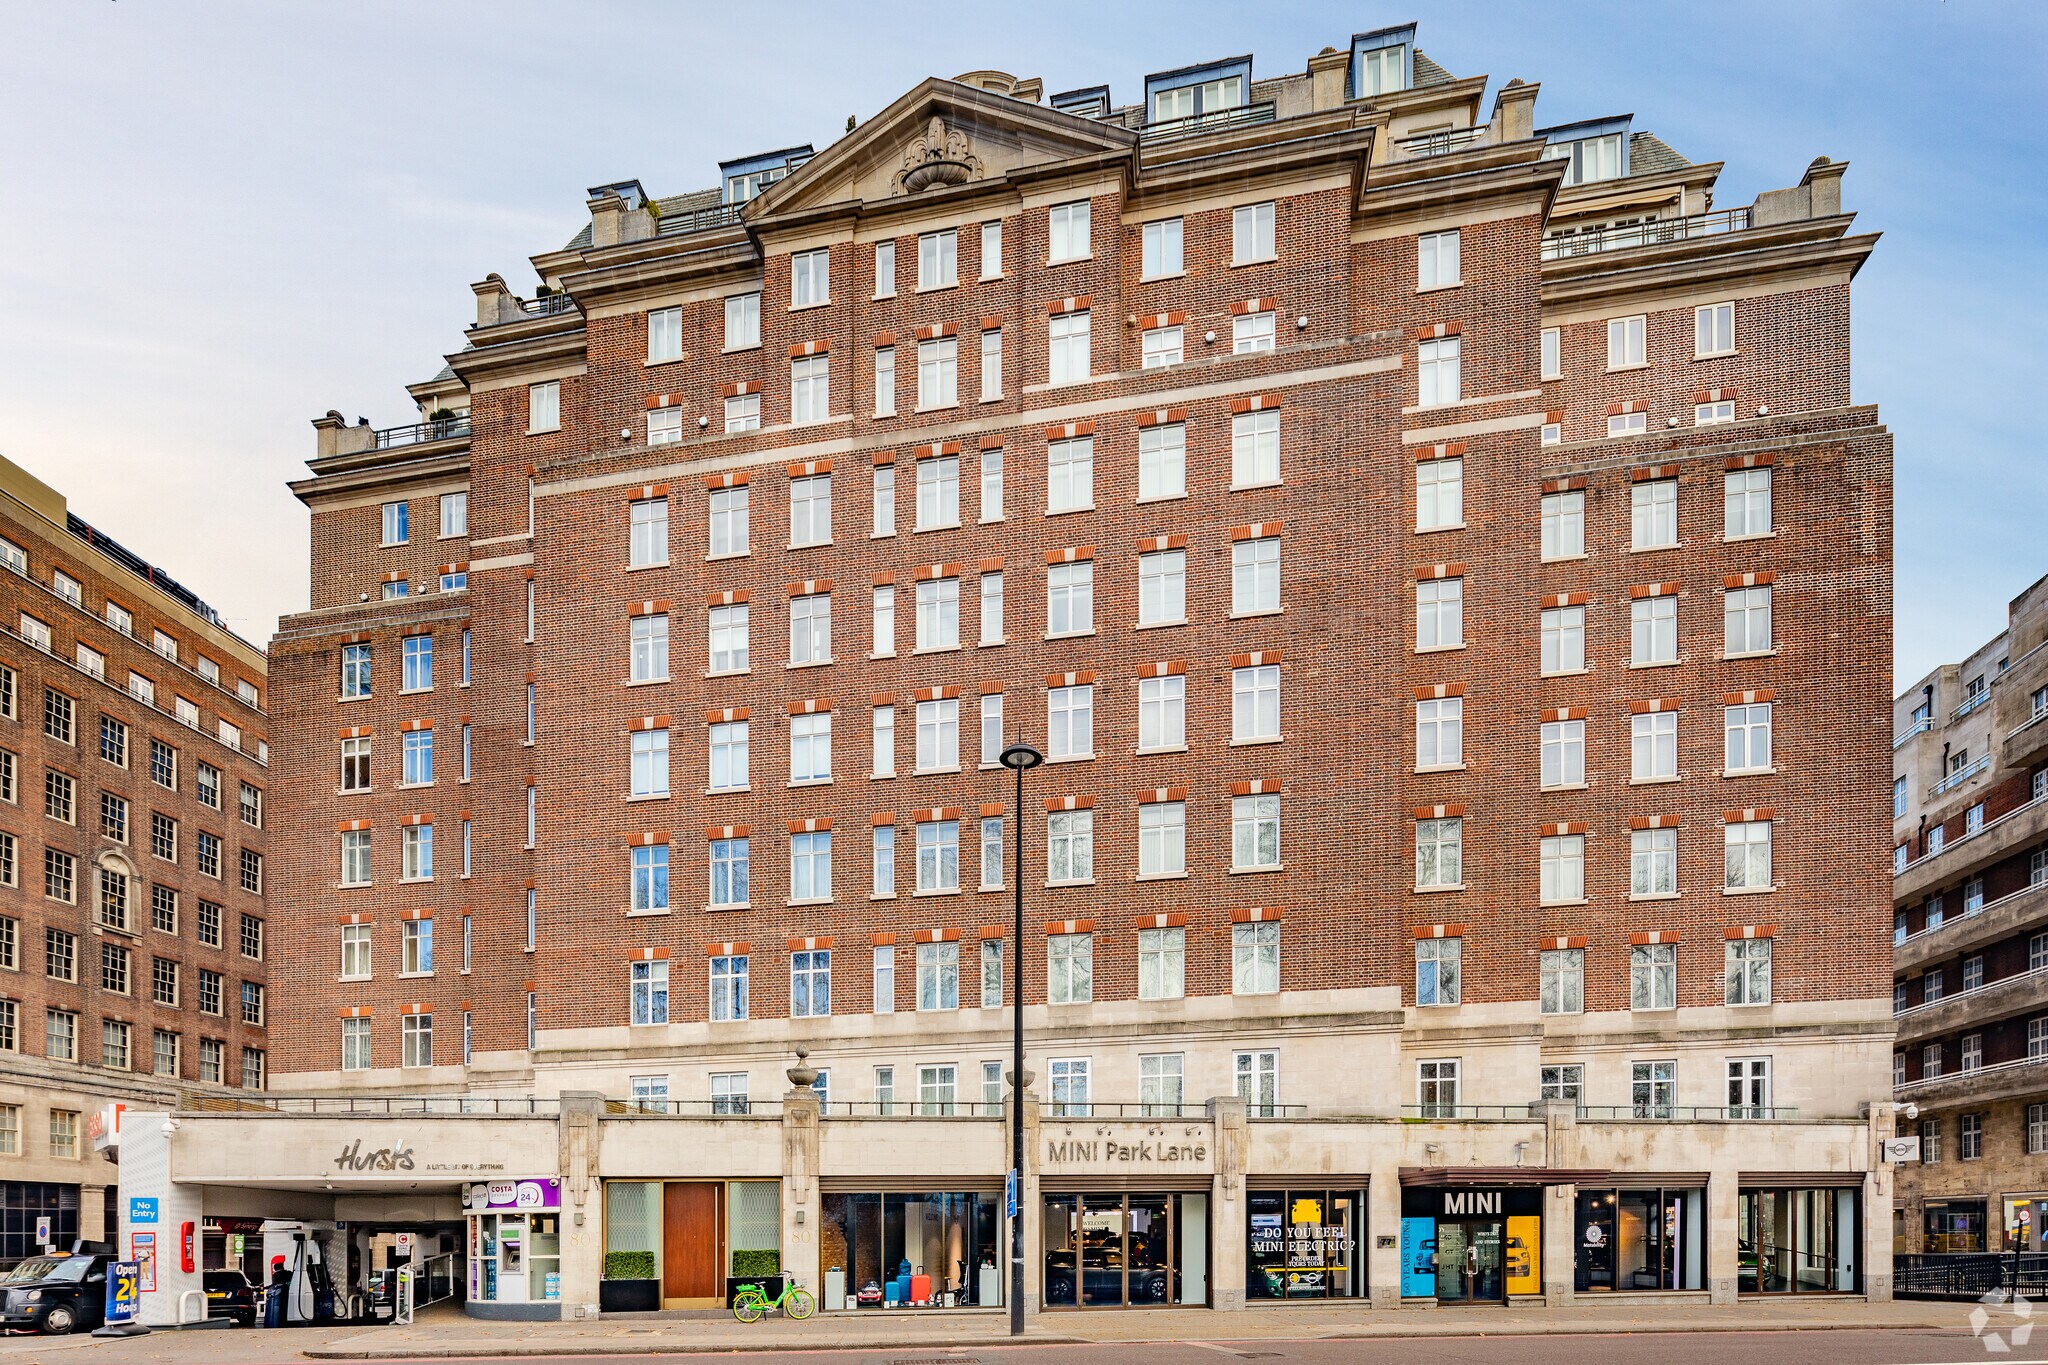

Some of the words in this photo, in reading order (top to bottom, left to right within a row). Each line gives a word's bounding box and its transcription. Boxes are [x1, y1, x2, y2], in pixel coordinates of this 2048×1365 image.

[334, 1138, 415, 1171] Hursts
[1049, 1141, 1098, 1162] MINI
[1106, 1140, 1152, 1161] Park
[1157, 1141, 1206, 1162] Lane
[520, 1193, 531, 1201] 24
[1444, 1192, 1502, 1214] MINI
[136, 1201, 151, 1209] No
[132, 1209, 156, 1219] Entry
[792, 1230, 810, 1244] 80
[1264, 1227, 1282, 1238] DO
[1287, 1227, 1311, 1238] YOU
[1315, 1226, 1347, 1237] FEEL
[1254, 1241, 1284, 1252] MINI
[1288, 1240, 1355, 1252] ELECTRIC?
[1381, 1238, 1391, 1246] 77
[115, 1264, 137, 1277] Open
[115, 1278, 138, 1302] 24
